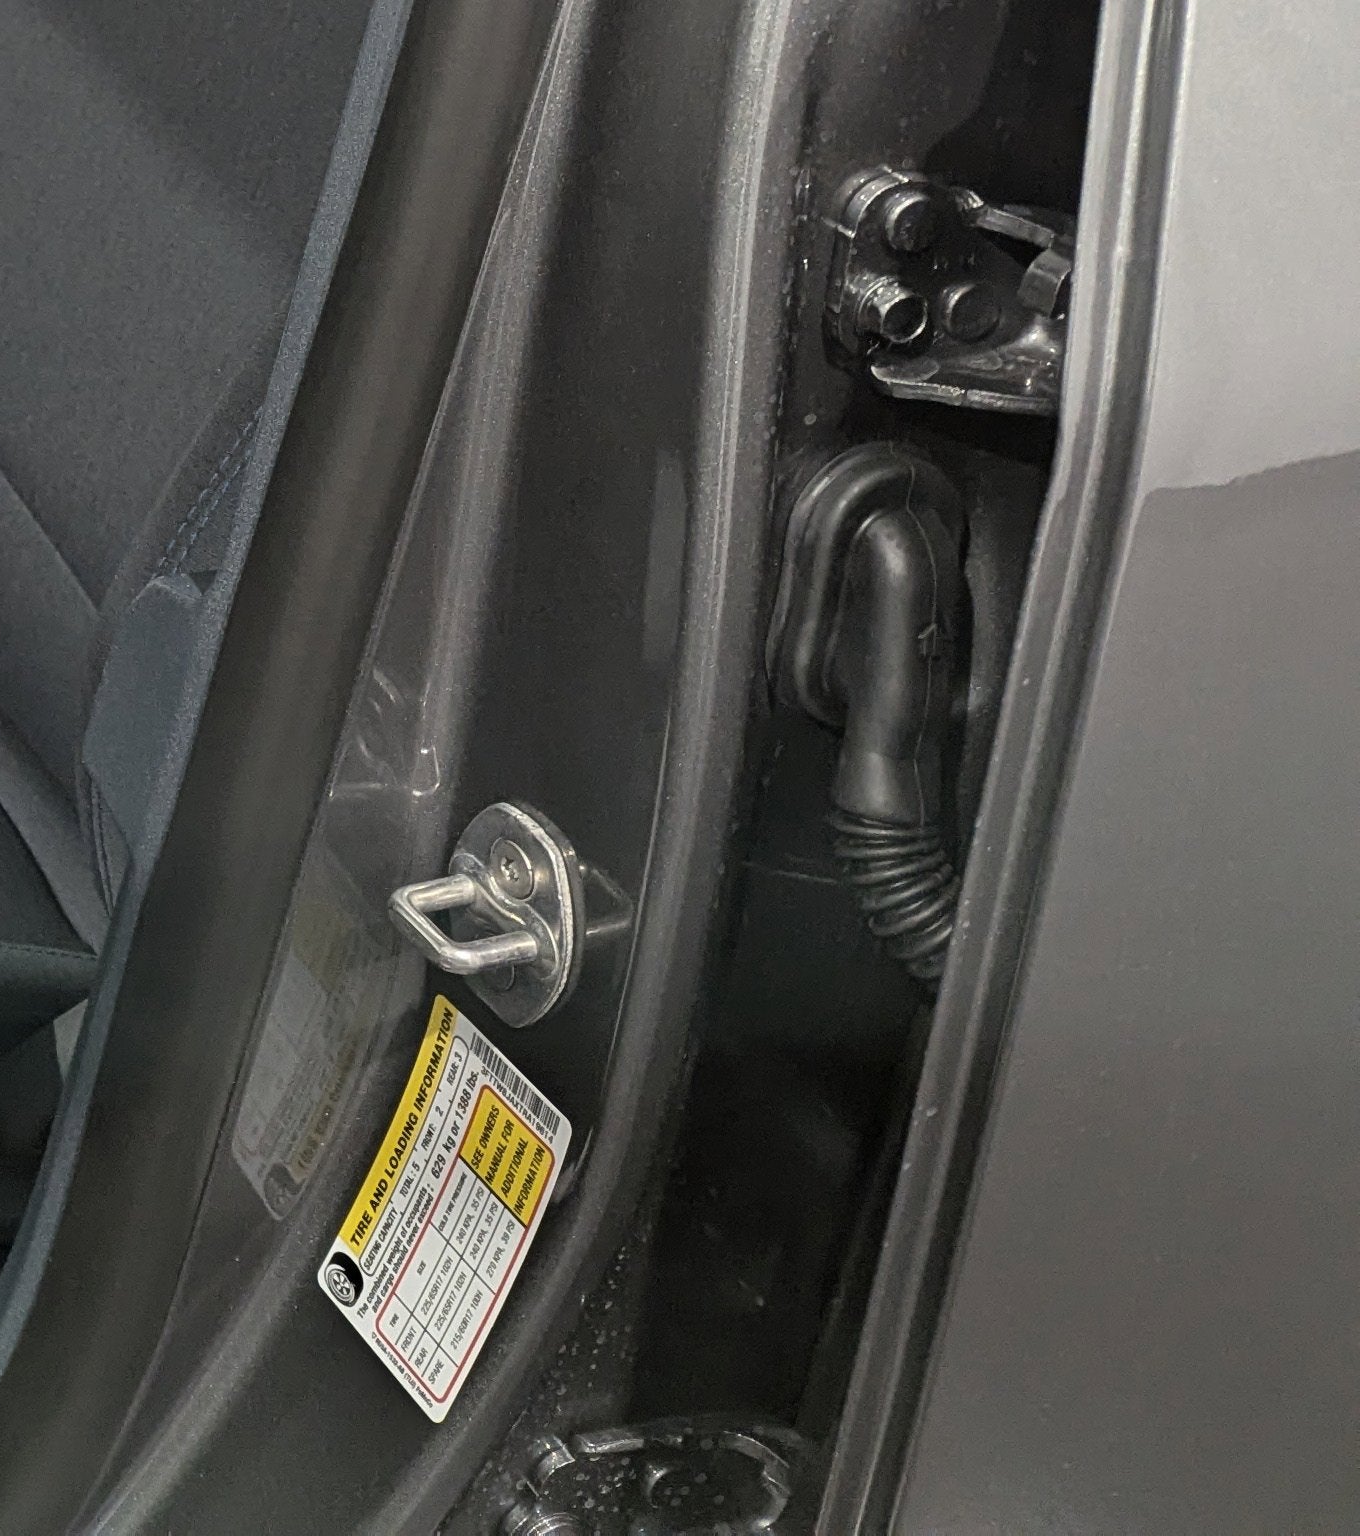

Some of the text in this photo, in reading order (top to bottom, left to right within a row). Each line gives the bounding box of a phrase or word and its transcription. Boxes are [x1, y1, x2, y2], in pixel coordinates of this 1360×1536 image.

[445, 1049, 463, 1086] REAR: 3
[349, 1006, 454, 1249] TIRE AND LOADING INFORMATION
[430, 1065, 479, 1180] 629 kg or 1388 lbs.
[434, 1103, 444, 1117] 2
[469, 1102, 500, 1170] SEE OWNERS
[484, 1117, 515, 1186] MANUAL FOR
[411, 1160, 421, 1173] 5
[499, 1134, 529, 1198] ADDITIONAL
[512, 1143, 545, 1216] INFORMATION
[437, 1213, 449, 1232] COLD
[450, 1170, 468, 1203] PRESSURE
[469, 1196, 480, 1212] 35
[474, 1184, 485, 1201] PSI
[356, 1184, 428, 1319] The combined weight of occupants
[362, 1205, 398, 1271] SEATING CAPACITY
[370, 1293, 383, 1314] and
[379, 1271, 396, 1299] cargo
[391, 1243, 409, 1275] should
[405, 1220, 420, 1248] never
[416, 1190, 434, 1224] exceed
[454, 1225, 467, 1246] 240
[468, 1241, 480, 1261] 240
[483, 1212, 493, 1227] 35
[488, 1200, 499, 1216] PSI
[484, 1259, 497, 1279] 270
[500, 1229, 510, 1245] 39
[505, 1217, 515, 1234] PSI
[415, 1258, 426, 1276] SIZE
[419, 1273, 444, 1316] 225/65R17
[433, 1289, 457, 1332] 225/65R17
[388, 1311, 399, 1329] TIRE
[400, 1325, 417, 1353] FRONT
[413, 1345, 428, 1369] REAR
[427, 1357, 444, 1386] SPARE
